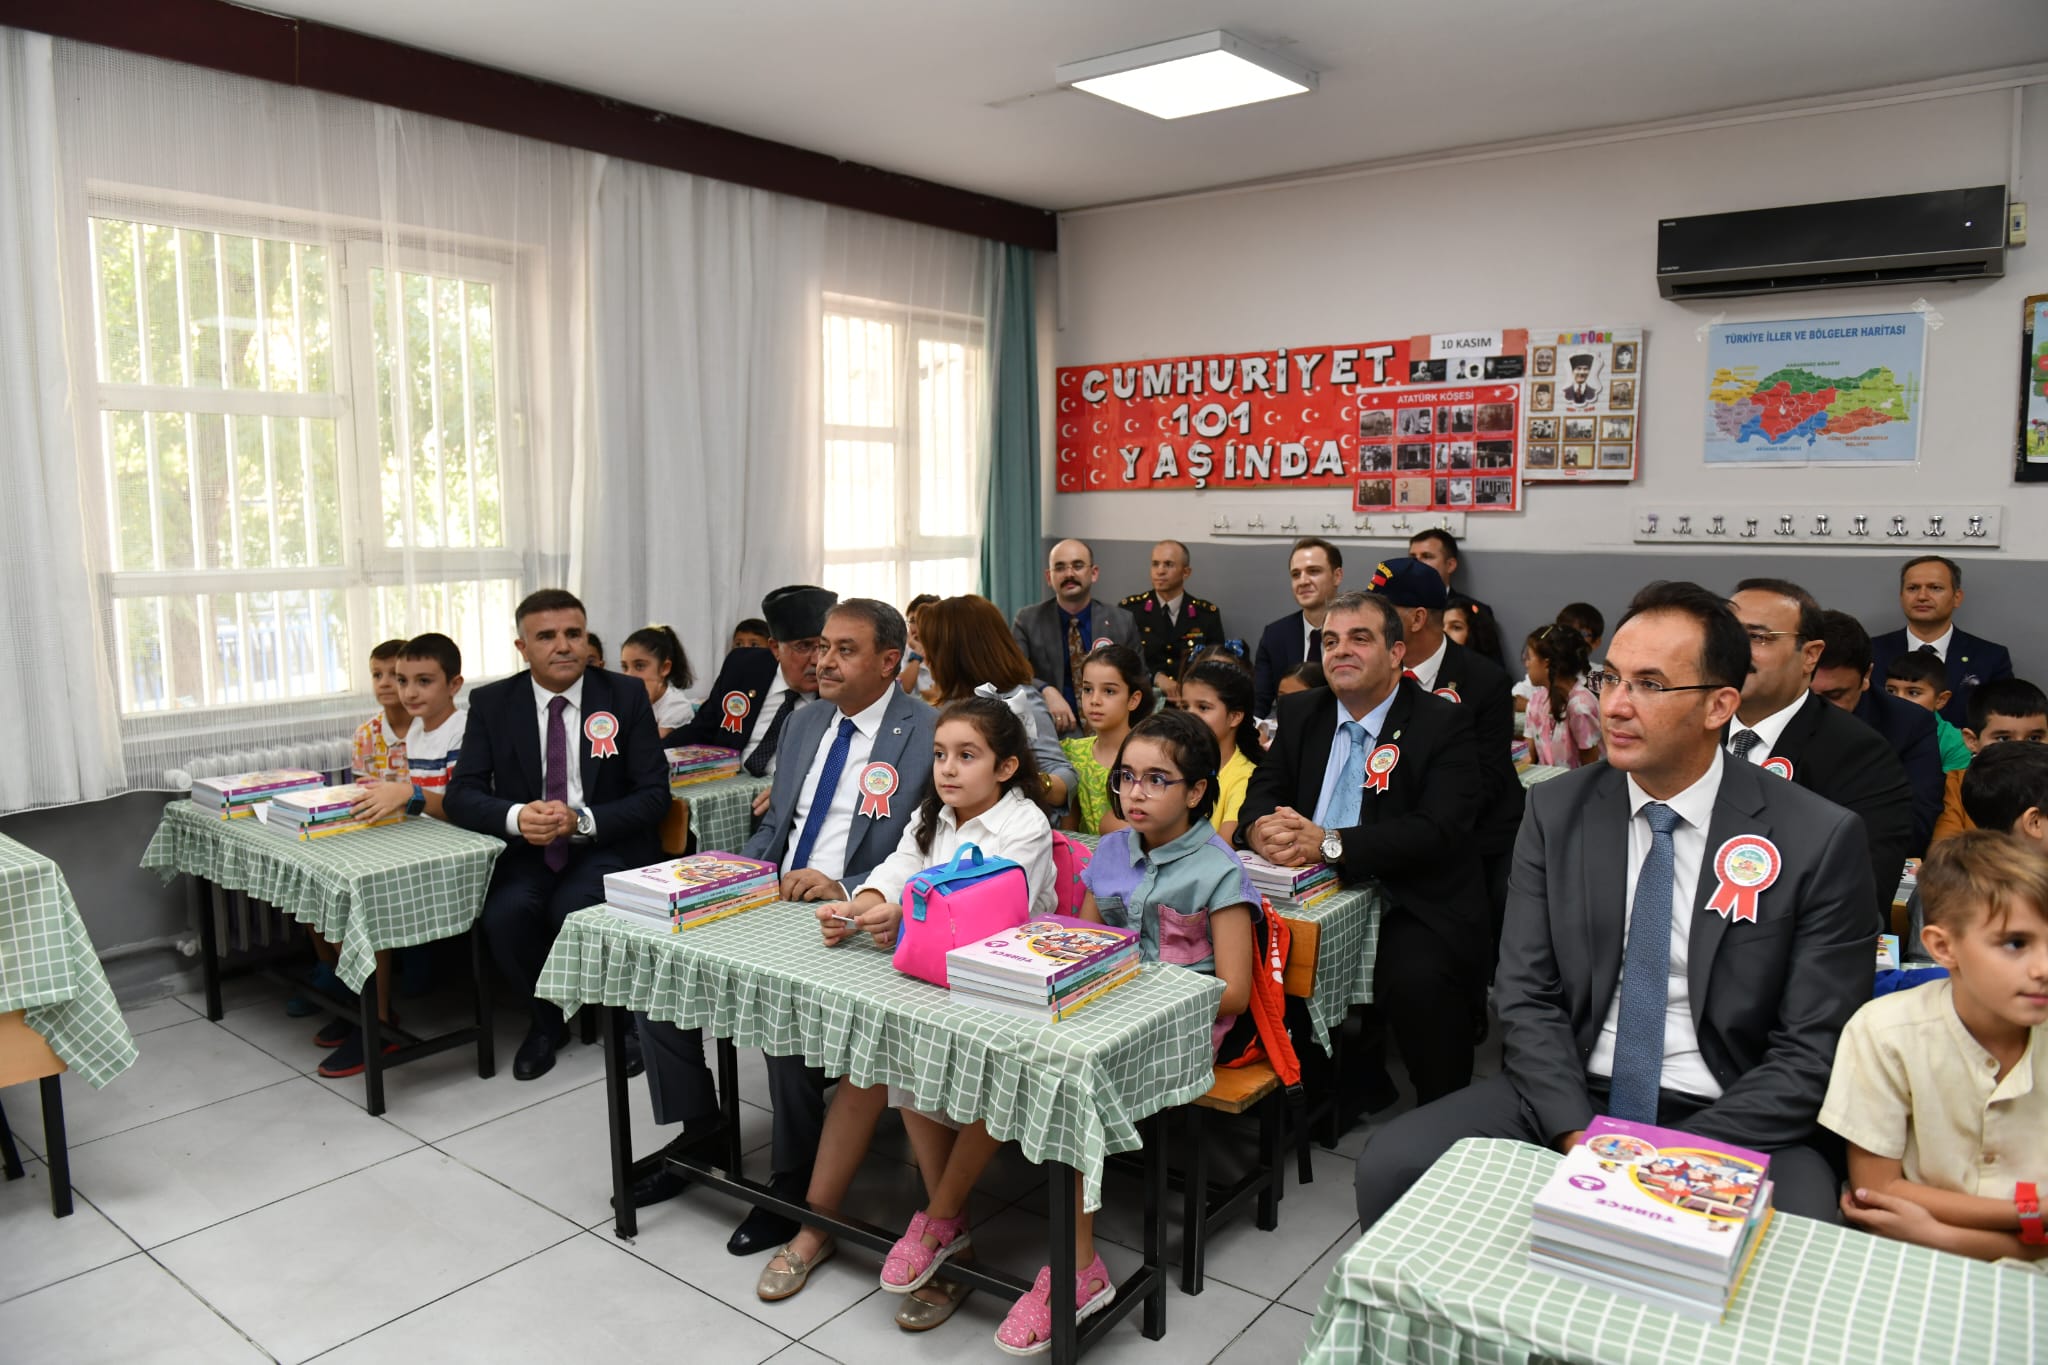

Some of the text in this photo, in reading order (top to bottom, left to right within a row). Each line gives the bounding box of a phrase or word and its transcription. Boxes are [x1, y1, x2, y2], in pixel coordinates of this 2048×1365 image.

[1557, 330, 1613, 345] ATATÜRK
[1725, 325, 1905, 344] TÜRKİYE İLLER VE BÖLGELER HARİTASI
[1441, 337, 1492, 350] 10 KASIM
[1082, 345, 1394, 403] CUMHURİYET
[1397, 390, 1474, 404] ATATÜRK KÖŞESİ
[1172, 401, 1251, 438] 101
